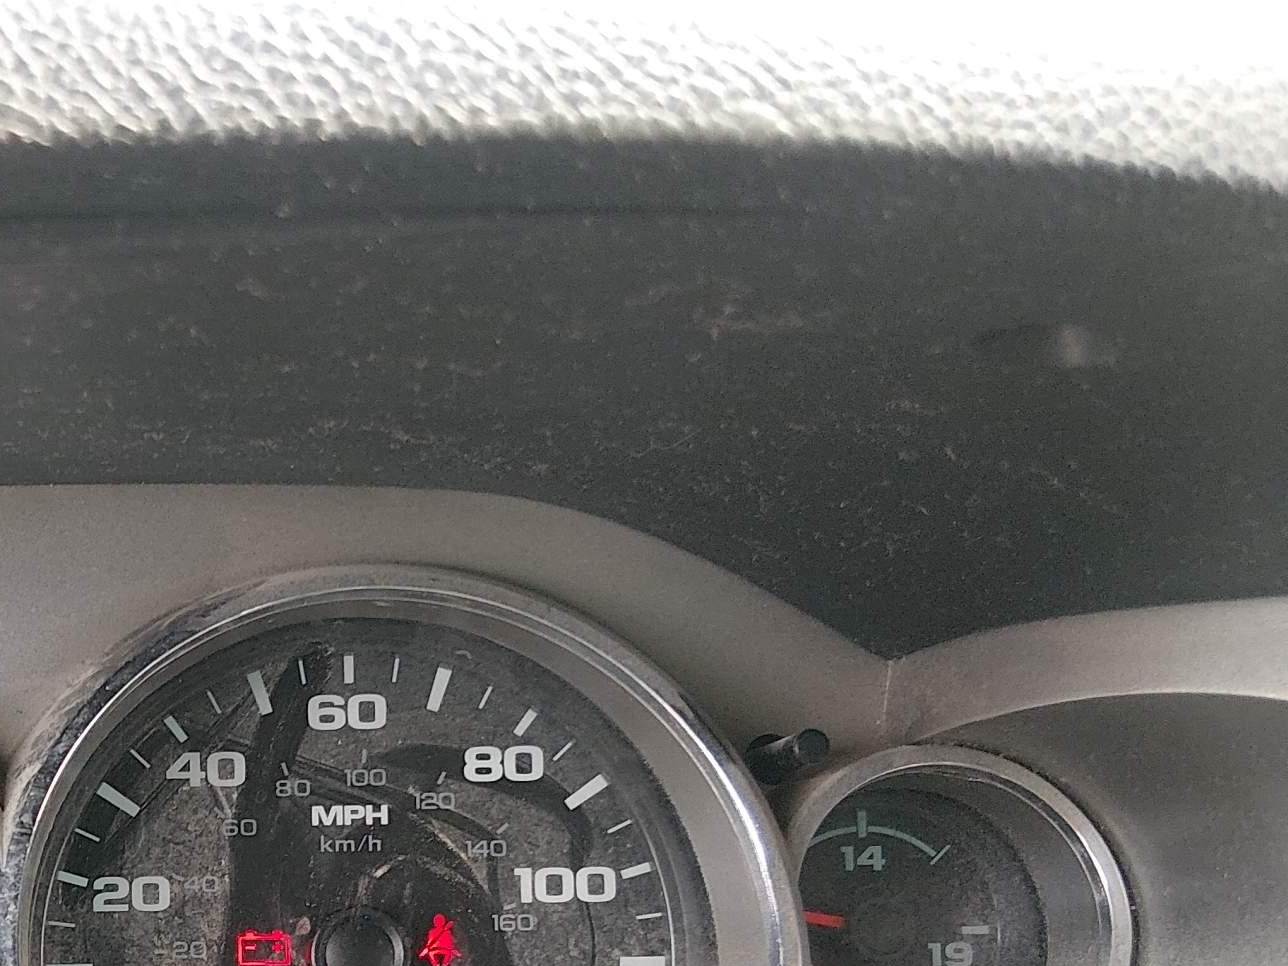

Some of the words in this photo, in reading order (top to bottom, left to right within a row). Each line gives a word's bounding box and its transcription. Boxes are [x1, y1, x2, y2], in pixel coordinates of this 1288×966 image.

[307, 694, 387, 730] 60
[166, 752, 246, 788] 40
[464, 746, 544, 782] 80
[344, 769, 387, 786] 100
[276, 779, 311, 797] 80
[414, 792, 456, 809] 120
[312, 805, 389, 826] MPH
[224, 819, 257, 836] 60
[319, 835, 382, 853] km/h
[466, 840, 507, 856] 140
[840, 845, 886, 871] 14
[513, 867, 616, 902] 100
[92, 876, 170, 913] 20
[492, 914, 535, 931] 160
